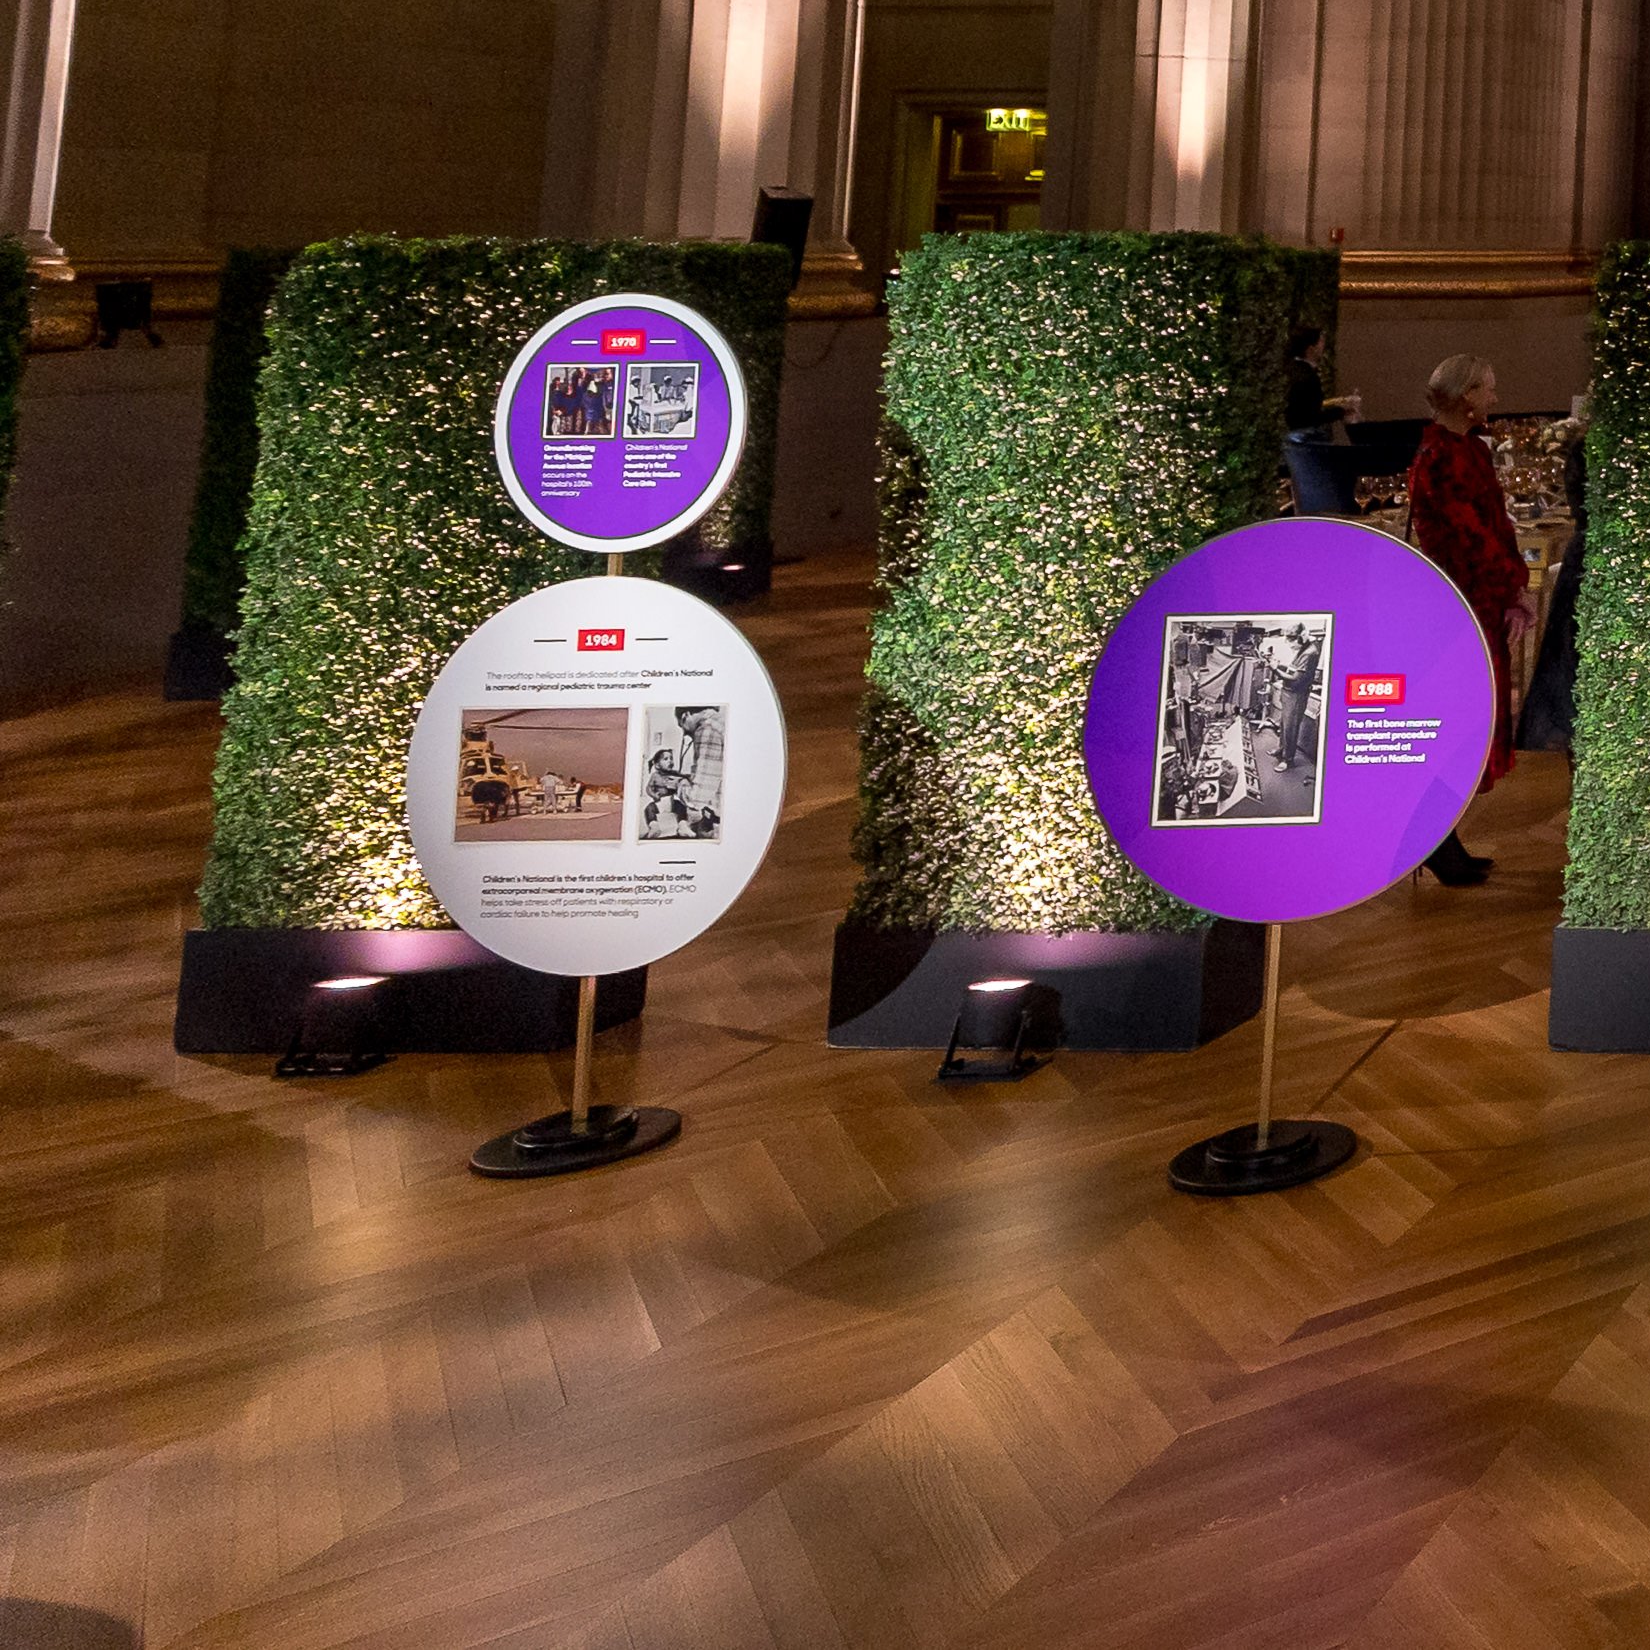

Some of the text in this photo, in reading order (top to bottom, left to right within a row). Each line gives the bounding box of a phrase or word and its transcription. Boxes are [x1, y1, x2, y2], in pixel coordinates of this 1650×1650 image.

[990, 108, 1030, 130] EXIT
[611, 337, 636, 347] 1970
[585, 634, 617, 646] 1984
[1358, 682, 1393, 696] 1988
[1347, 719, 1442, 728] The first bone marrow
[1346, 730, 1437, 741] transplant procedure
[1353, 743, 1401, 754] performed
[1400, 743, 1412, 751] at
[1344, 753, 1426, 764] Children's National
